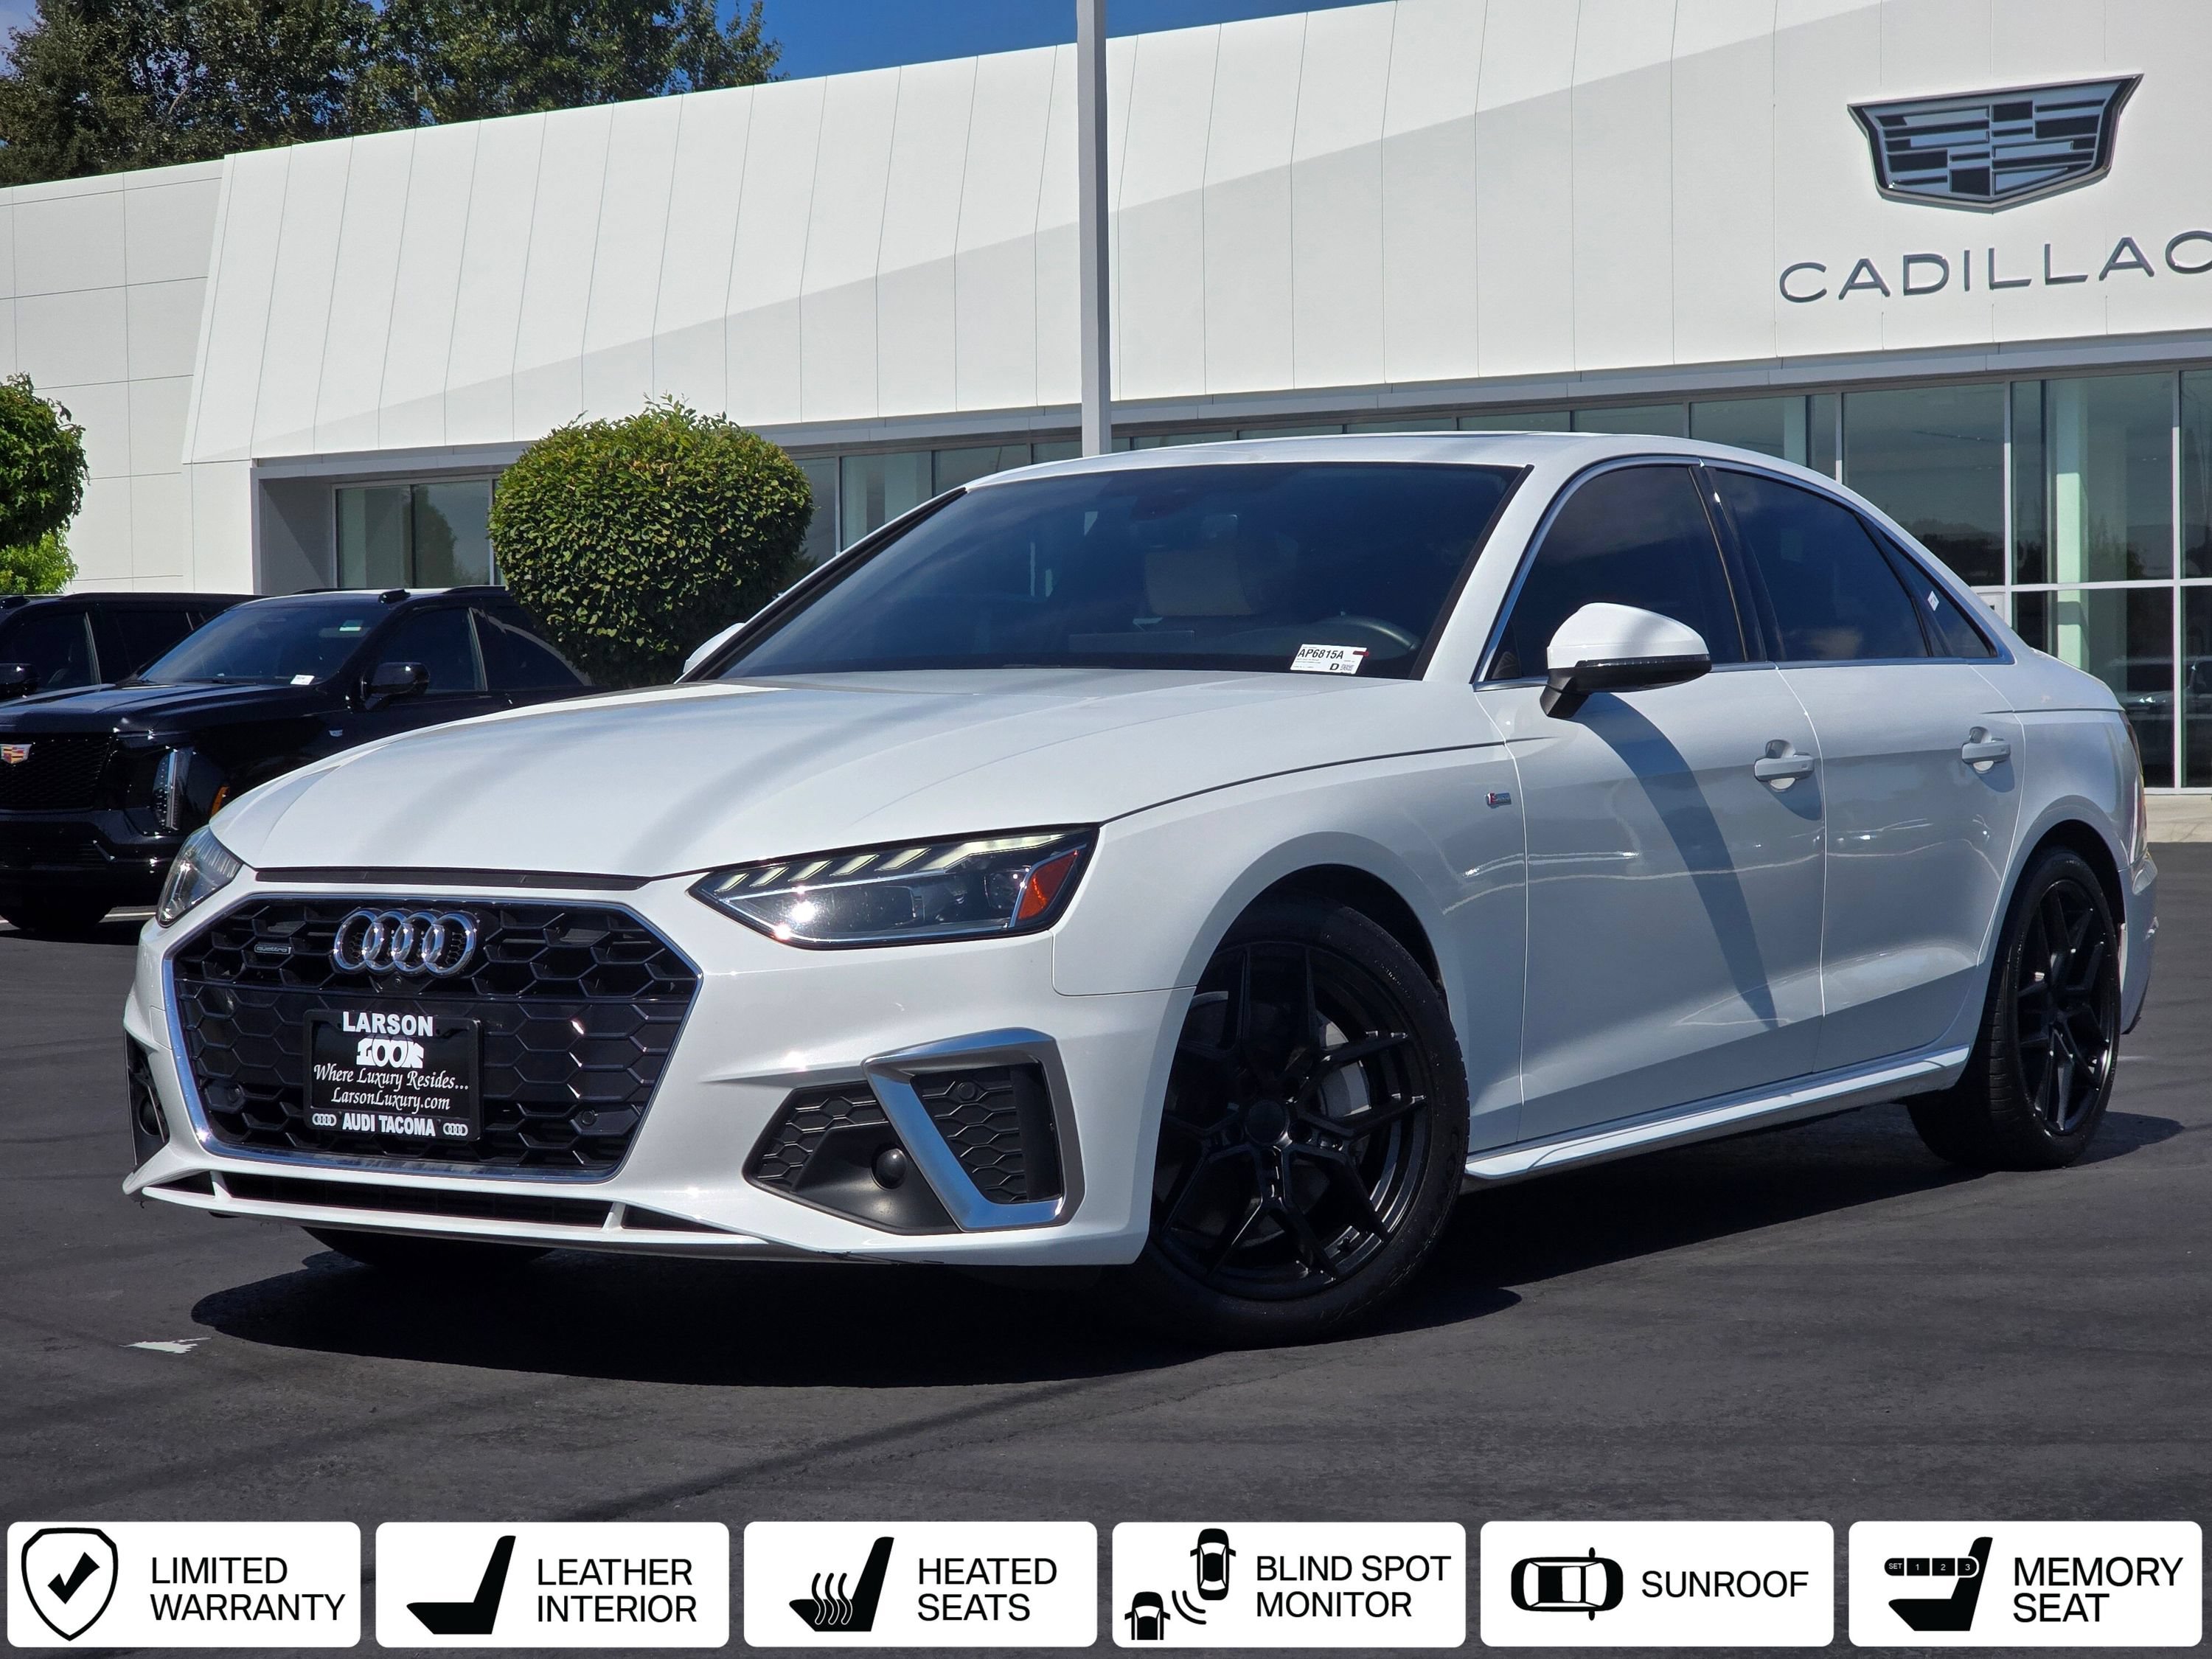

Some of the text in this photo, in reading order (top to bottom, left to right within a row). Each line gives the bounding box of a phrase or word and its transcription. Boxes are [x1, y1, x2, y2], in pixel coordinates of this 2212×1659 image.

[1298, 648, 1344, 659] AP6815A
[1329, 663, 1340, 671] D
[342, 1011, 434, 1037] LARSON
[313, 1062, 469, 1093] Where Luxury Resides...
[330, 1087, 451, 1115] LarsonLuxury.com
[342, 1113, 437, 1136] AUDI TACOMA
